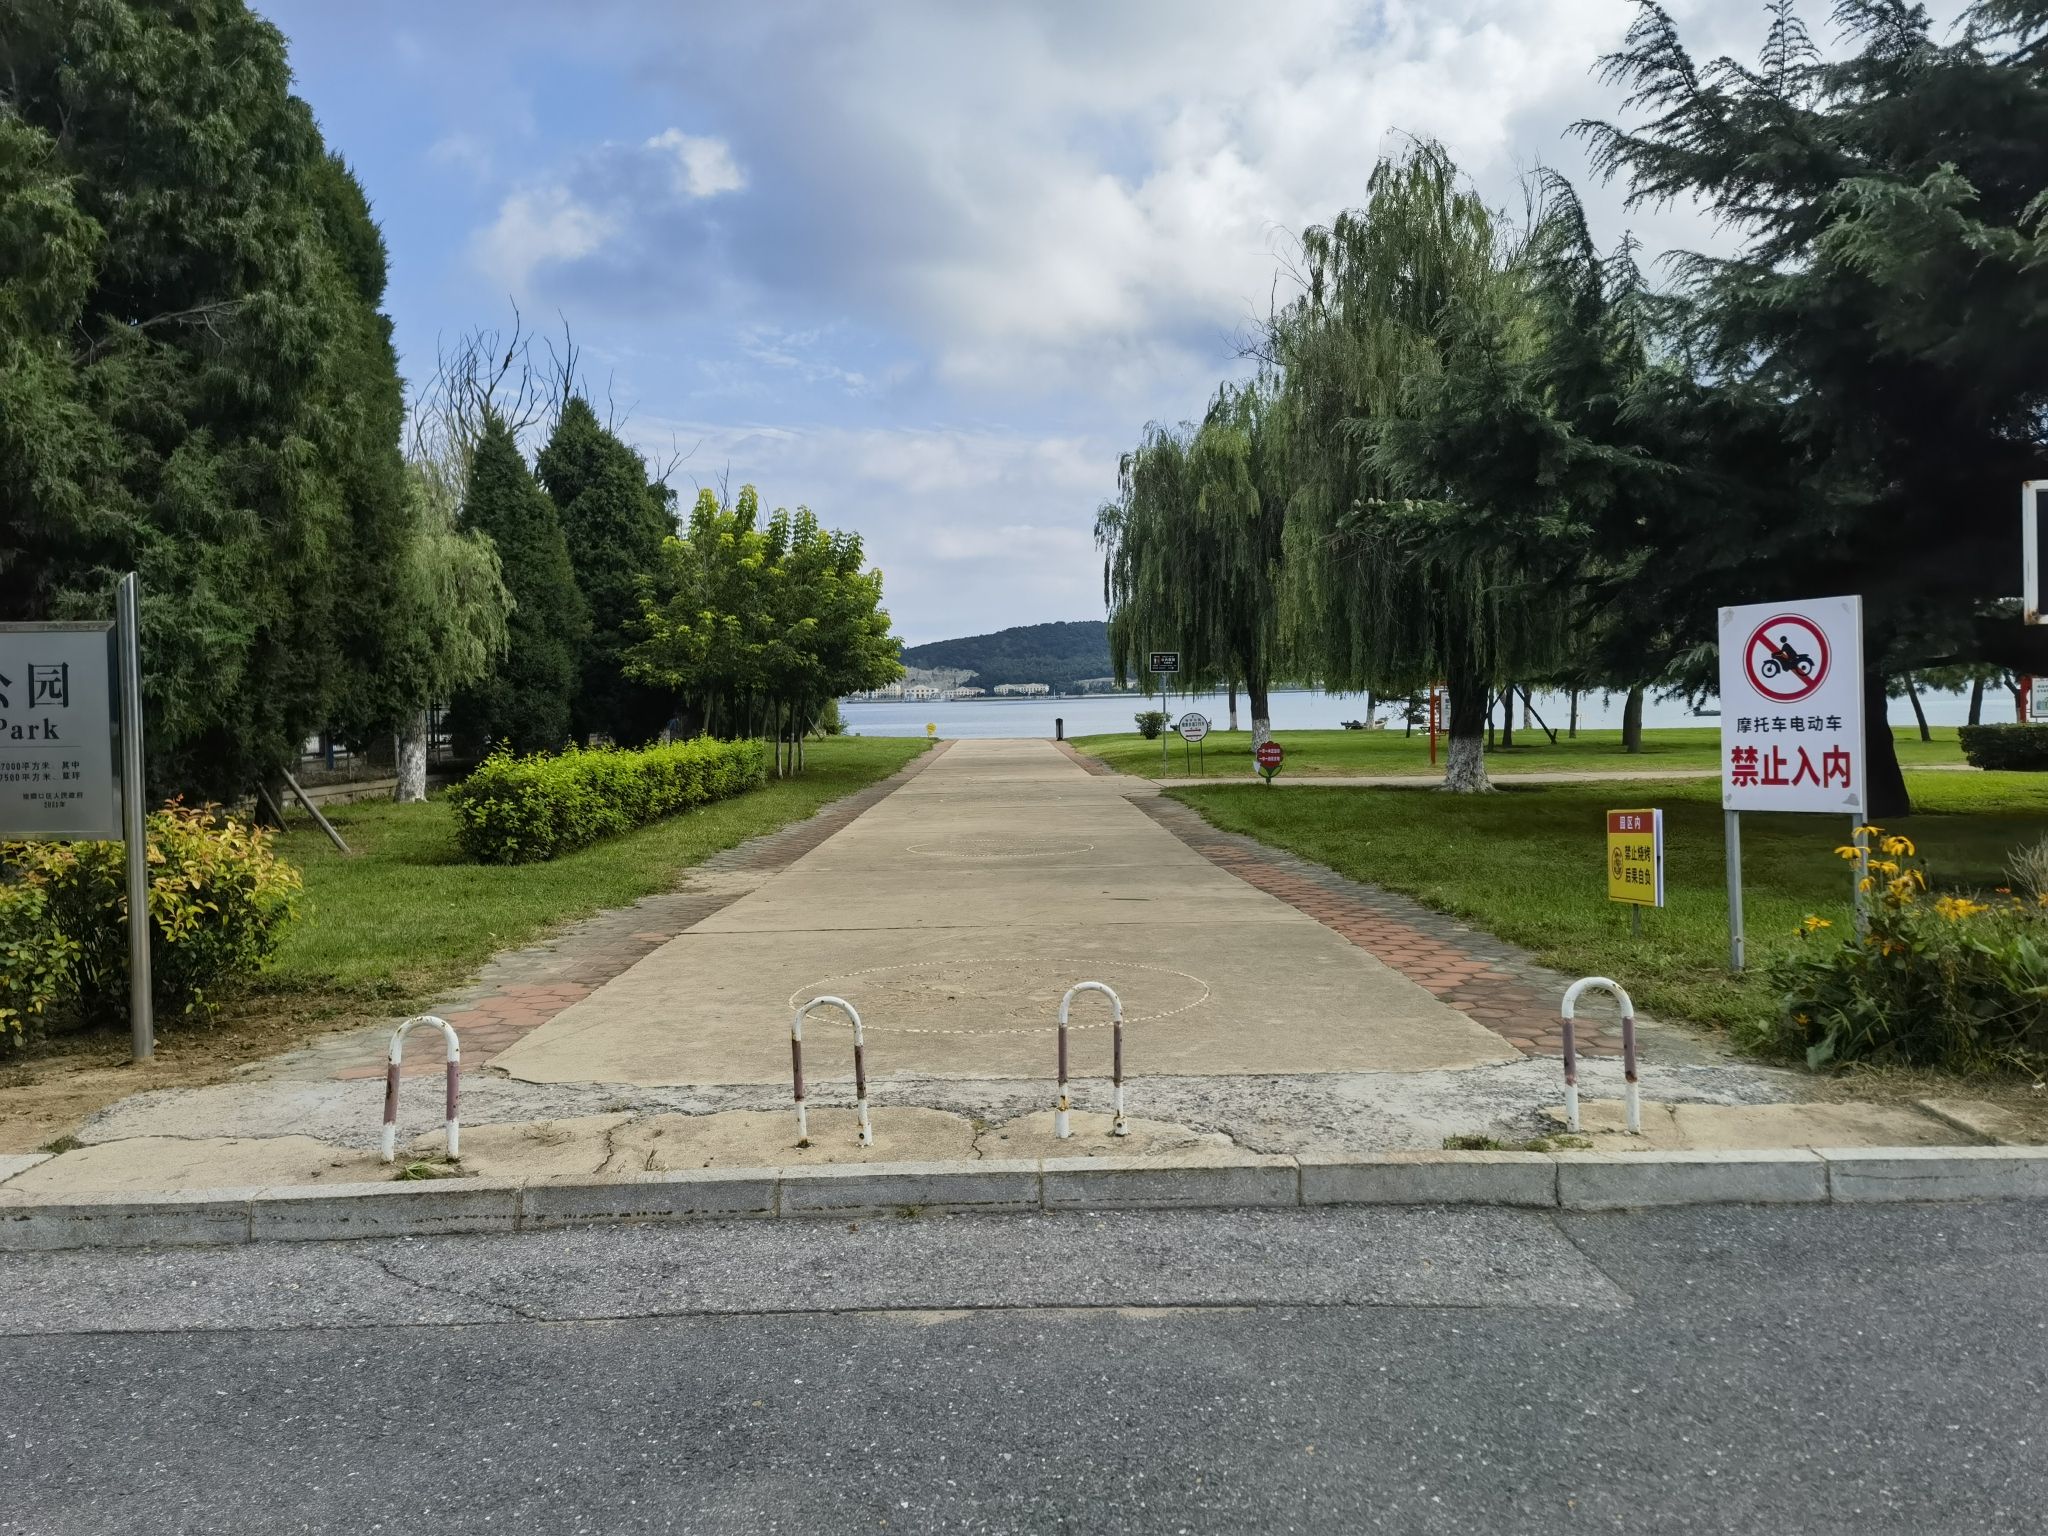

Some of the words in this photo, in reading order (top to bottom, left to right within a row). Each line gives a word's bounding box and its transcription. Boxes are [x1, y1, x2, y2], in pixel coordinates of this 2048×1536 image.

[1736, 714, 1842, 733] 摩托车电动车
[1731, 744, 1851, 788] 禁止入内
[1625, 845, 1651, 862] 禁止烧烤
[1625, 867, 1651, 885] 后果自负
